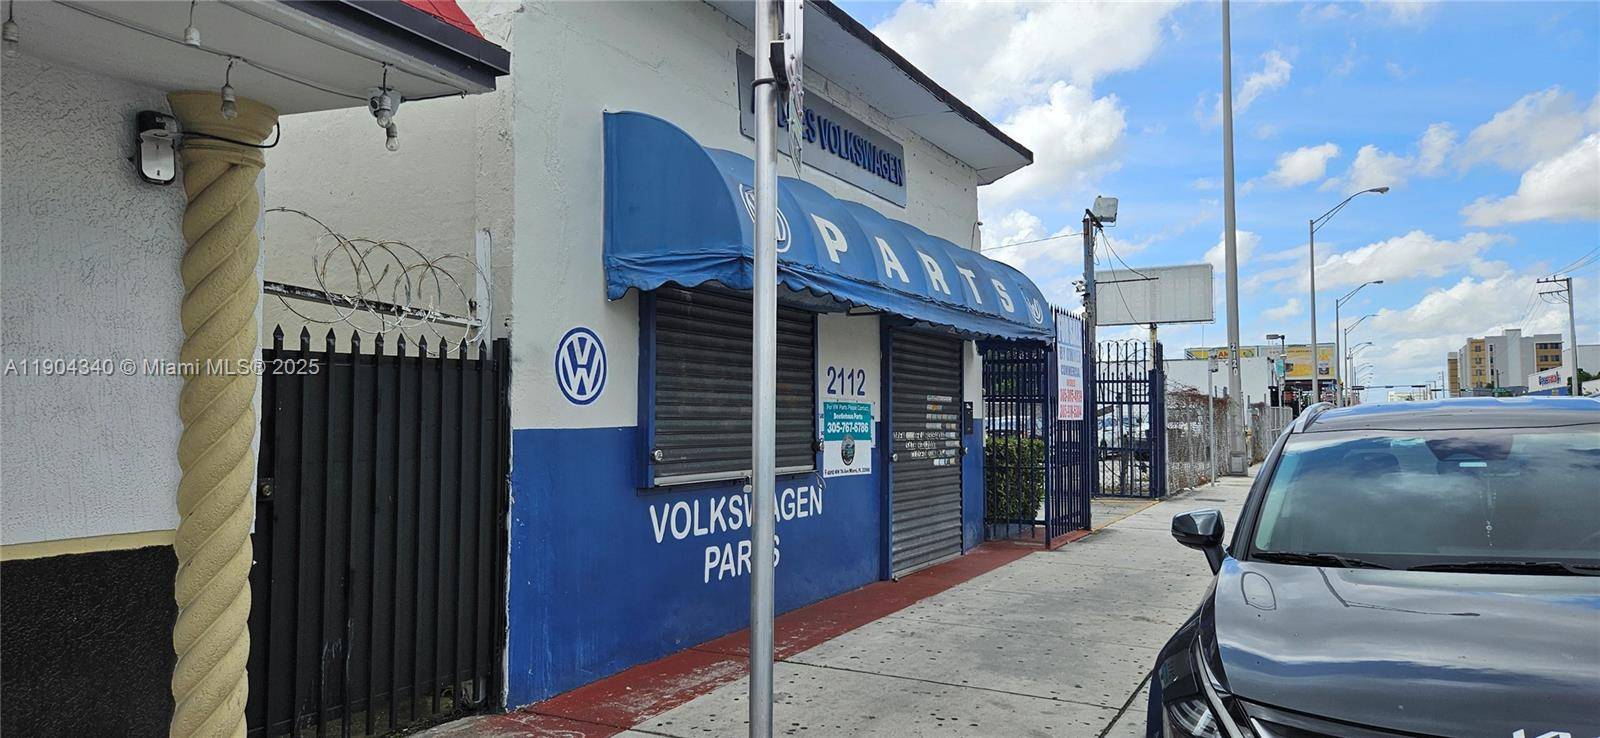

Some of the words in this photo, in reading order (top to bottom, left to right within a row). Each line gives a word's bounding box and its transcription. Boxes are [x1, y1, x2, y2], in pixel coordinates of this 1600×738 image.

[817, 114, 904, 187] VOLKSWAGEN
[811, 213, 1014, 313] PARTS
[827, 366, 866, 397] 2112
